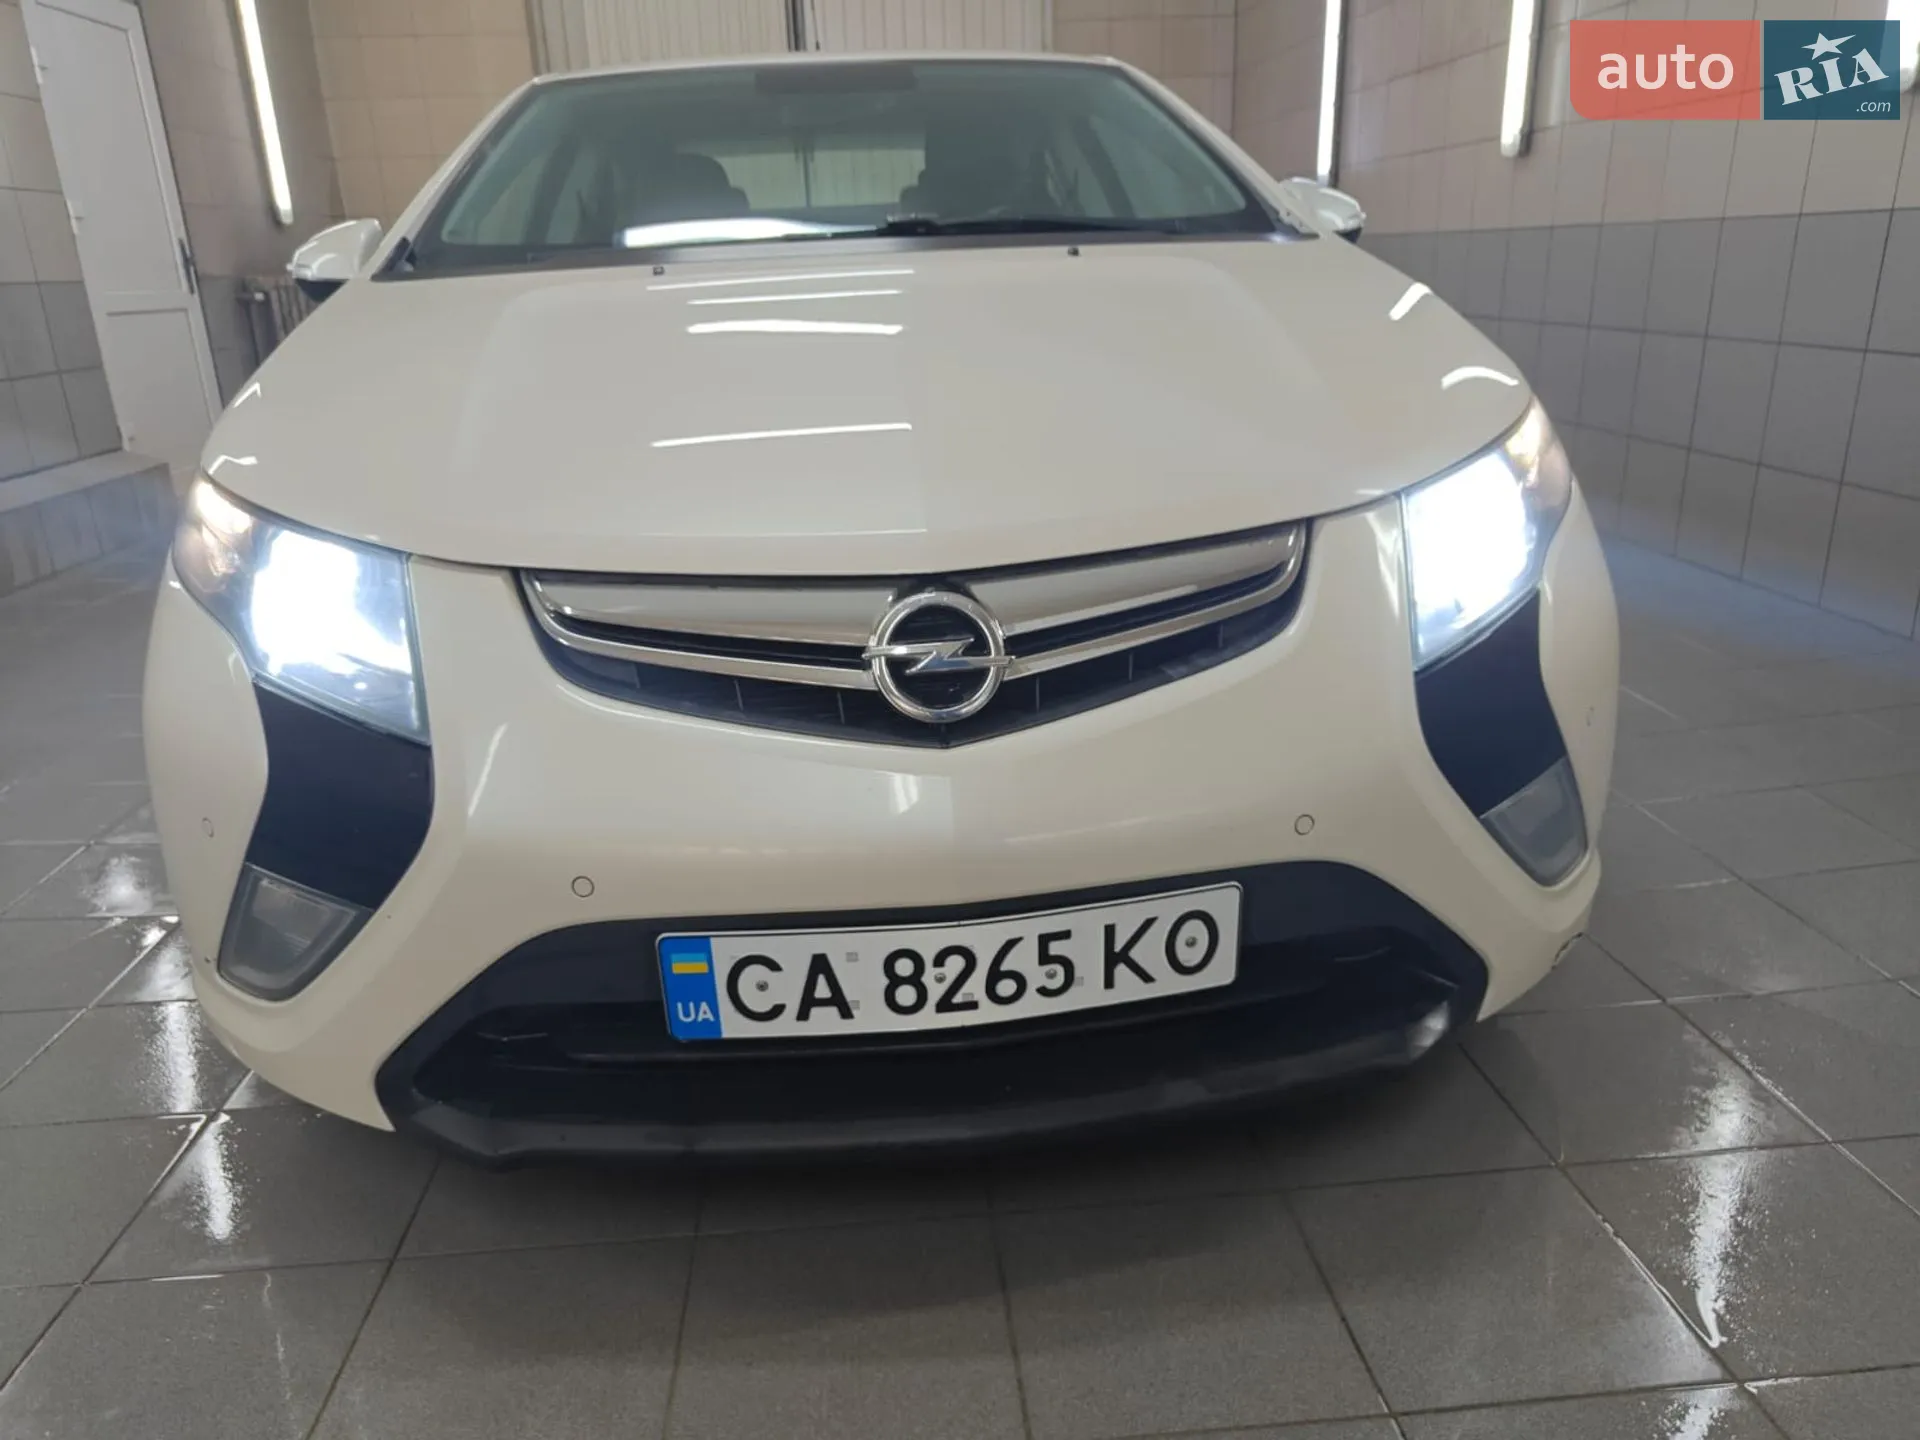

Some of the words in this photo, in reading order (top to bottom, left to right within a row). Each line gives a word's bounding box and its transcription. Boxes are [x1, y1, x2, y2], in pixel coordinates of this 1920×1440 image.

[725, 952, 854, 1022] CA
[882, 929, 1076, 1016] 8265
[1102, 909, 1219, 990] KO
[677, 1000, 714, 1023] UA
